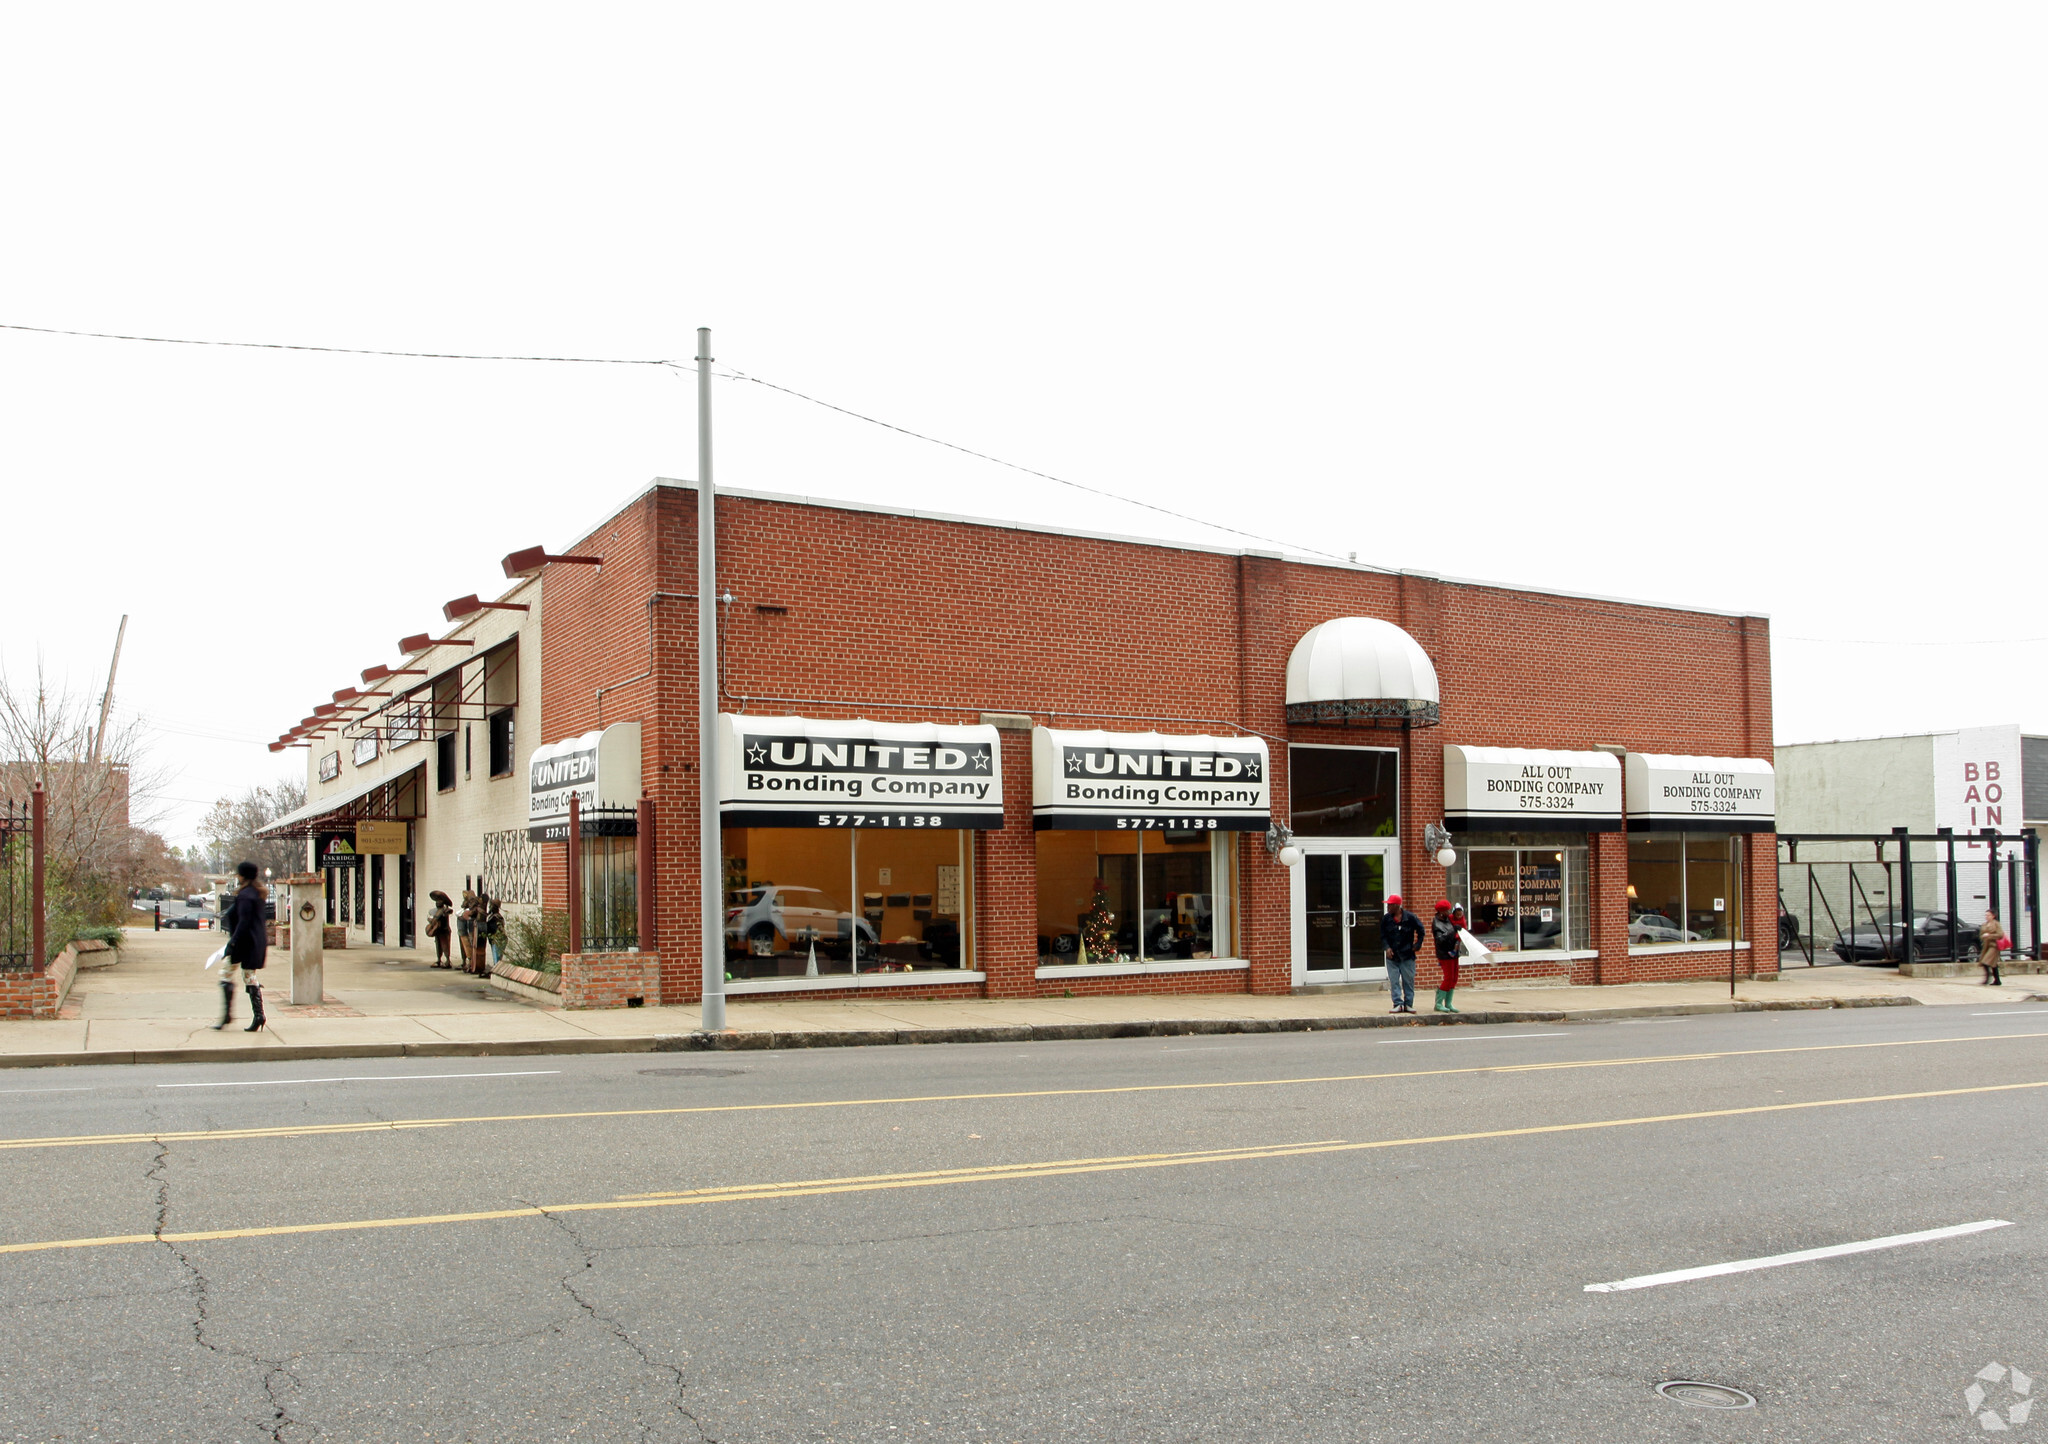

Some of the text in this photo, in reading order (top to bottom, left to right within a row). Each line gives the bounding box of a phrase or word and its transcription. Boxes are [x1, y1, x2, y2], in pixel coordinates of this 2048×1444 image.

[770, 742, 968, 770] UNITED
[537, 755, 591, 786] UNITED
[1085, 753, 1242, 777] UNITED
[1521, 765, 1572, 779] ALL OUT
[1692, 772, 1735, 785] ALL OUT
[747, 773, 991, 800] Bonding Company
[1487, 779, 1604, 795] BONDING COMPANY
[1663, 786, 1762, 800] BONDING COMPANY
[531, 790, 595, 812] Bonding Coany
[1066, 784, 1261, 806] Bonding Company
[1520, 795, 1574, 809] 575-3324
[1691, 800, 1737, 812] 575-3324
[1964, 762, 1982, 849] BAIL
[818, 815, 942, 827] 577-1138
[1117, 819, 1218, 829] 577-1138
[545, 826, 571, 839] 577-11
[1498, 865, 1538, 876] ALL OUT
[1472, 879, 1562, 890] BONDING COMPANY
[1497, 906, 1541, 917] 575-3324
